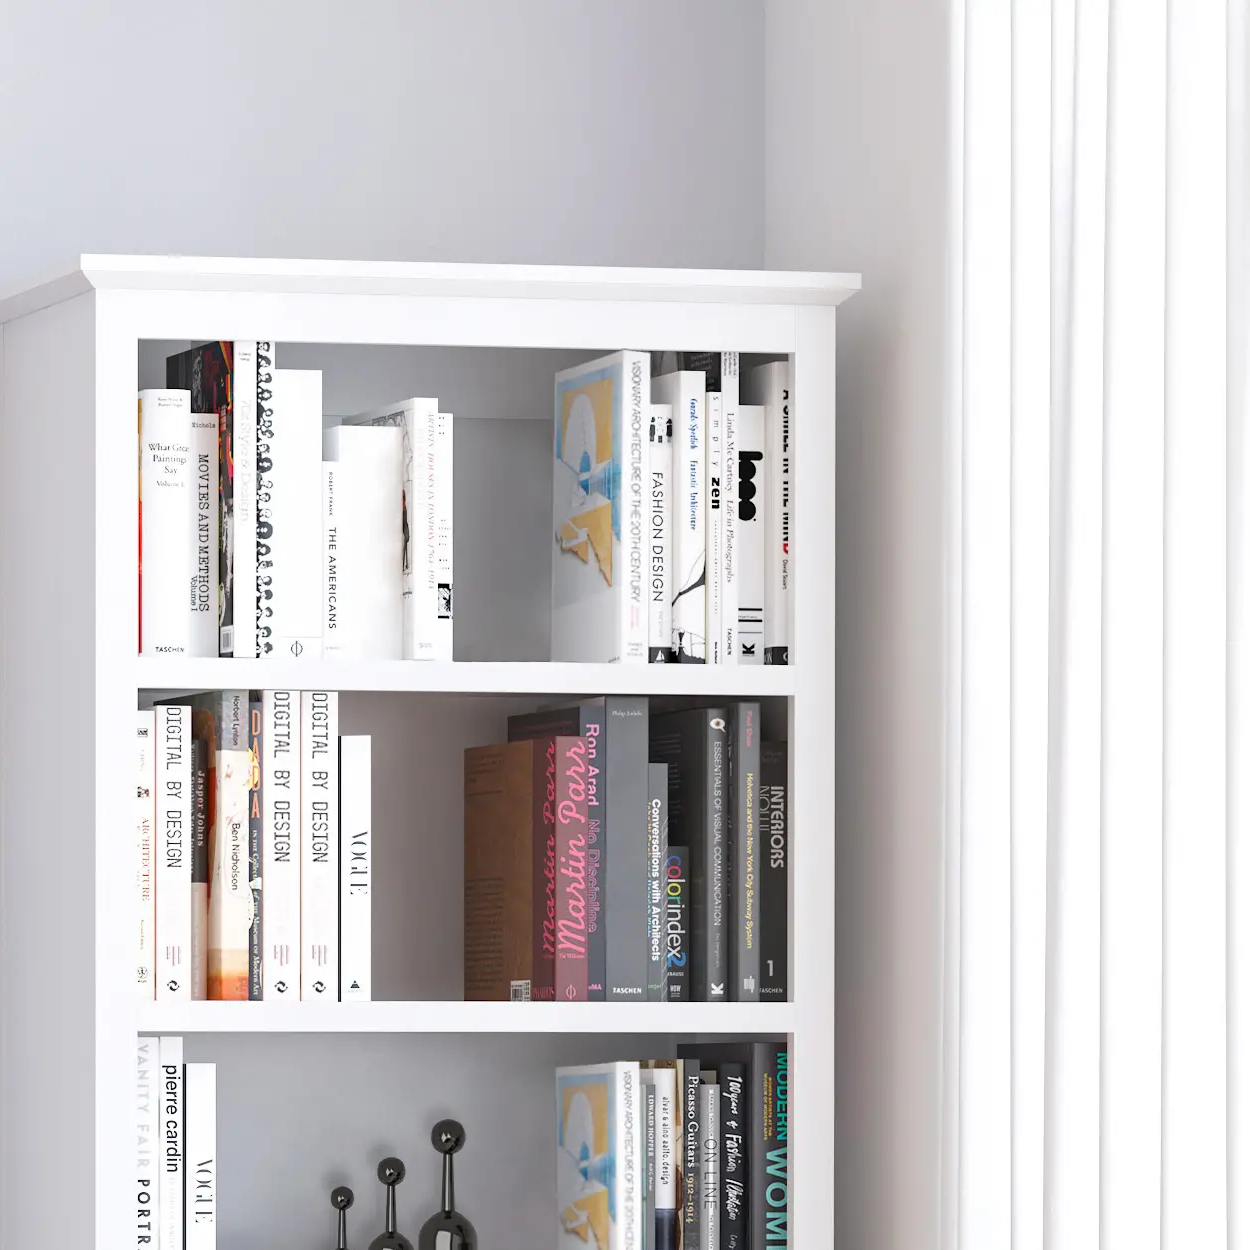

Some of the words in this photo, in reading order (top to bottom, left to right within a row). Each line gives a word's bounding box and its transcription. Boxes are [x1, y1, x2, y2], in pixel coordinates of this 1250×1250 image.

[631, 361, 642, 408] VISIONARY
[631, 409, 642, 482] ARCHITECTURE
[725, 413, 735, 438] Linda
[164, 466, 179, 476] Say
[199, 454, 210, 511] MOVIES
[631, 483, 642, 497] OF
[631, 499, 642, 519] THE
[652, 472, 664, 539] FASHION
[711, 477, 721, 510] zen
[725, 500, 735, 515] Life
[199, 514, 210, 543] AND
[328, 527, 337, 551] THE
[725, 517, 735, 526] in
[631, 551, 642, 602] CENTURY
[652, 546, 664, 602] DESIGN
[725, 529, 735, 583] Photographs
[199, 546, 210, 612] METHODS
[328, 556, 337, 630] AMERICANS
[166, 707, 182, 769] DIGITAL
[274, 691, 290, 758] DIGITAL
[312, 692, 328, 759] DIGITAL
[587, 723, 600, 759] Ron
[166, 781, 182, 799] BY
[197, 771, 206, 809] Jasper
[274, 770, 290, 789] BY
[312, 771, 328, 789] BY
[542, 741, 555, 825] Parr
[557, 741, 586, 825] Parr
[587, 765, 600, 806] Arad
[714, 741, 722, 797] ESSENTIALS
[746, 773, 754, 807] Helvetica
[714, 798, 722, 811] OF
[746, 808, 754, 823] and
[166, 811, 182, 868] DESIGN
[197, 812, 206, 847] Johns
[231, 823, 240, 842] Ben
[274, 801, 290, 862] DESIGN
[312, 801, 328, 863] DESIGN
[651, 799, 661, 878] Conversations
[714, 813, 722, 845] VISUAL
[746, 824, 754, 836] the
[746, 837, 754, 854] New
[770, 786, 784, 868] INTERIORS
[231, 844, 240, 891] Nicholson
[350, 831, 368, 895] VOGUE
[746, 855, 754, 873] York
[746, 874, 754, 889] City
[542, 834, 555, 953] Martin
[557, 834, 586, 953] Martin
[651, 880, 661, 903] with
[714, 847, 722, 926] COMMUNICATION
[746, 890, 754, 920] Subway
[651, 906, 661, 961] Architects
[746, 921, 754, 949] System
[612, 987, 642, 995] TASCHEN
[137, 1043, 152, 1114] VANITY
[161, 1064, 179, 1114] pierre
[687, 1075, 700, 1119] Picasso
[776, 1052, 788, 1140] MODERN
[661, 1096, 670, 1114] alvar
[137, 1123, 152, 1168] FAIR
[165, 1119, 182, 1172] cardin
[661, 1123, 670, 1138] aino
[687, 1124, 700, 1168] Guitars
[725, 1134, 742, 1172] Fashion
[195, 1159, 213, 1223] VOGUE
